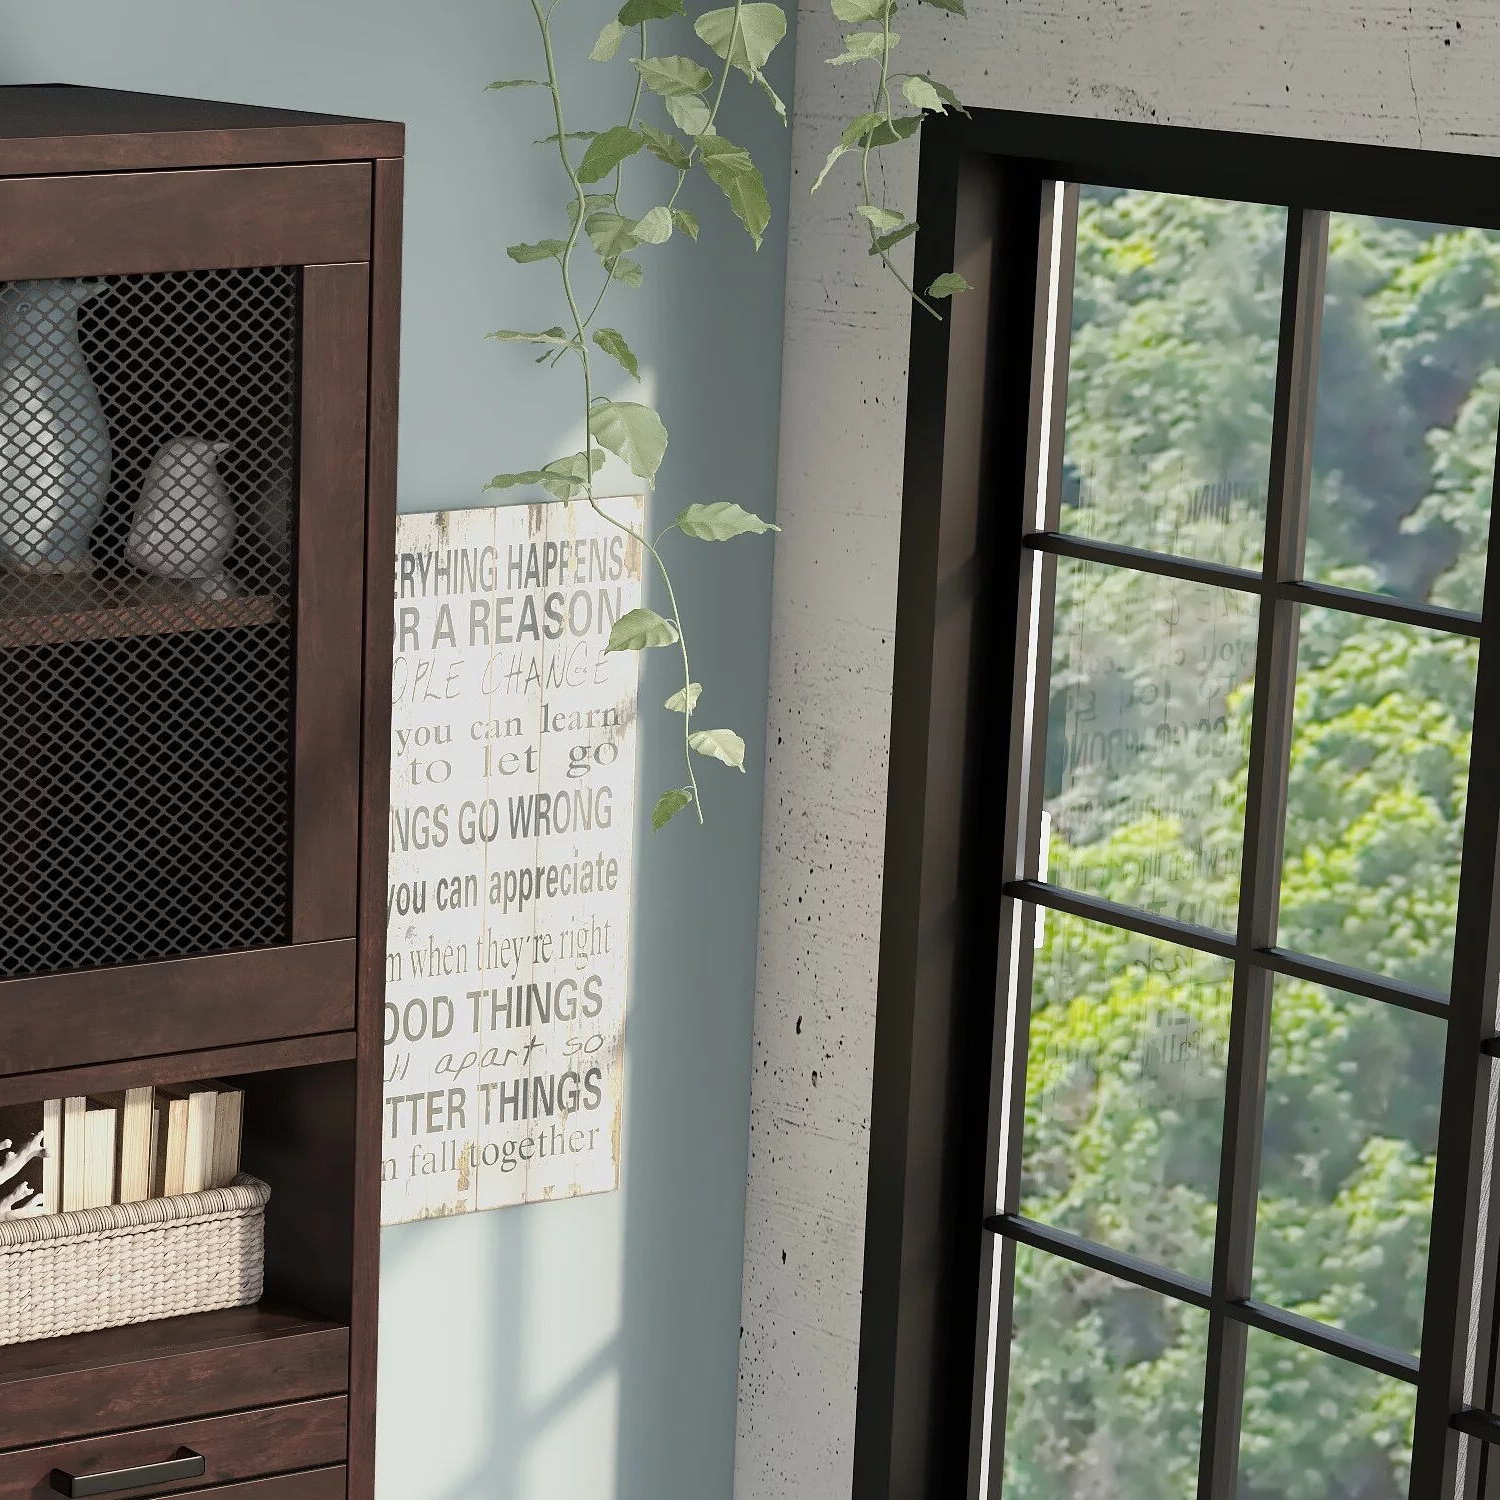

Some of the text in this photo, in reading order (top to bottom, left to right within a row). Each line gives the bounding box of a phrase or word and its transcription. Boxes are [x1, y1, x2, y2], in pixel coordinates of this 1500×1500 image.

[507, 535, 624, 591] HAPPENS
[393, 587, 622, 652] R A REASON
[481, 641, 609, 696] CHANGE
[395, 702, 622, 757] you can learn
[409, 742, 619, 786] to let go
[458, 798, 500, 846] GO
[508, 786, 613, 840] WRONG
[436, 872, 478, 912] can
[489, 847, 619, 914] appreciate
[410, 933, 469, 979] when
[476, 926, 553, 981] they're
[558, 914, 612, 971] right
[466, 974, 604, 1035] THINGS
[434, 1034, 545, 1081] apart
[562, 1032, 605, 1057] so
[476, 1067, 602, 1125] THINGS
[409, 1139, 460, 1178] fall
[469, 1123, 600, 1173] together
